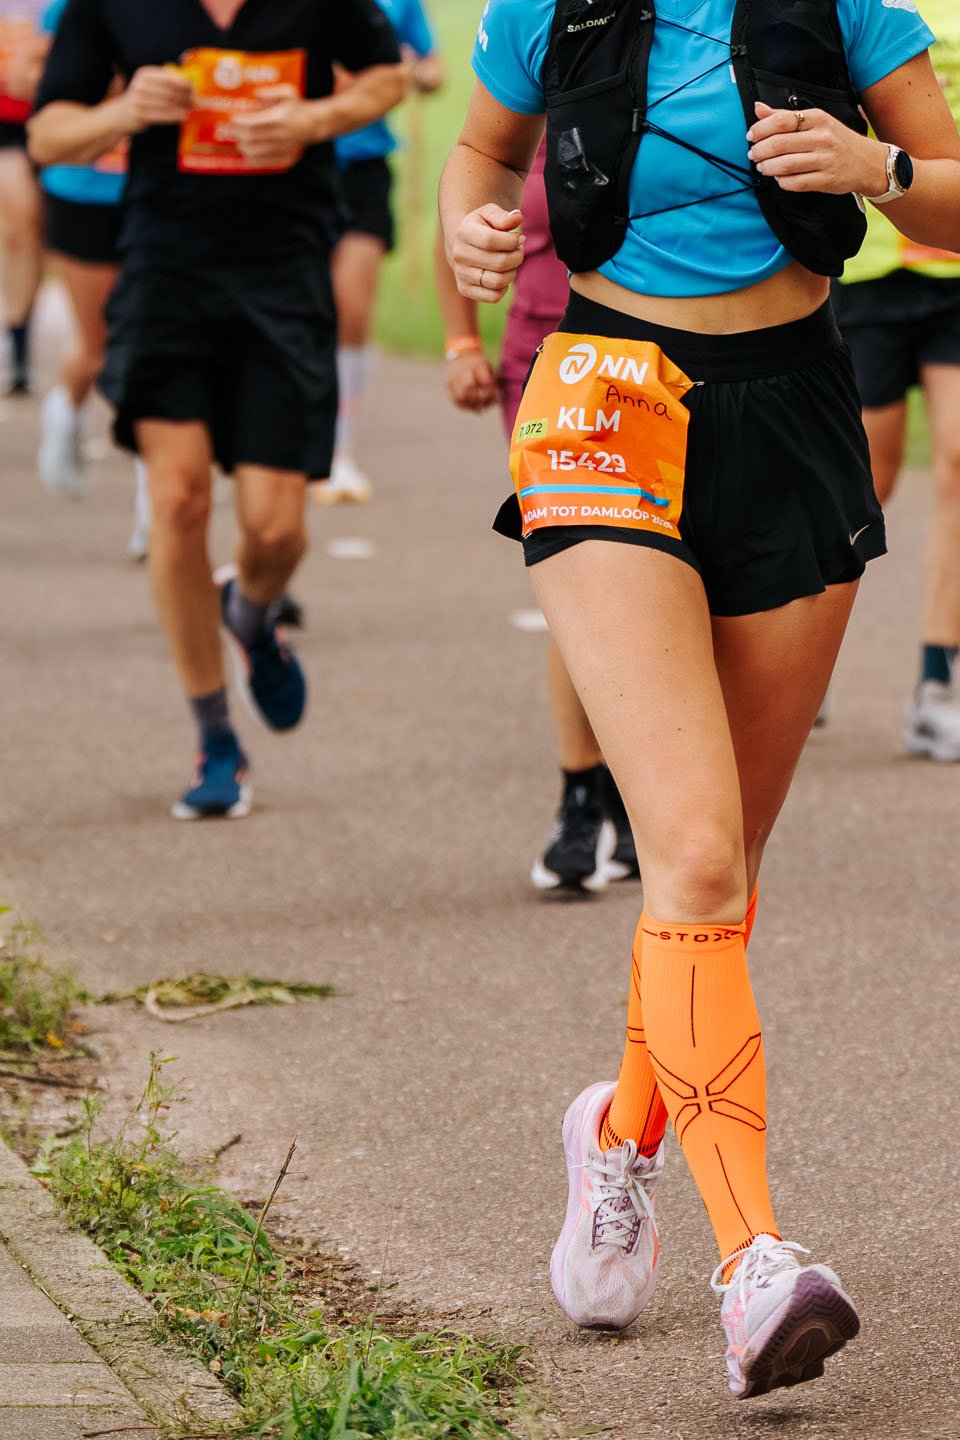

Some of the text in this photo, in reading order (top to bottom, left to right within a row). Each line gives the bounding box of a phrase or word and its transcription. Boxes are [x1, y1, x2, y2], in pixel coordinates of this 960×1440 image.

[598, 354, 649, 385] NN
[606, 385, 673, 421] Anna
[557, 406, 621, 433] KLM
[527, 506, 547, 522] DAM
[550, 506, 578, 517] TOT
[580, 506, 649, 521] DAMLOOP
[659, 931, 731, 943] STOX
